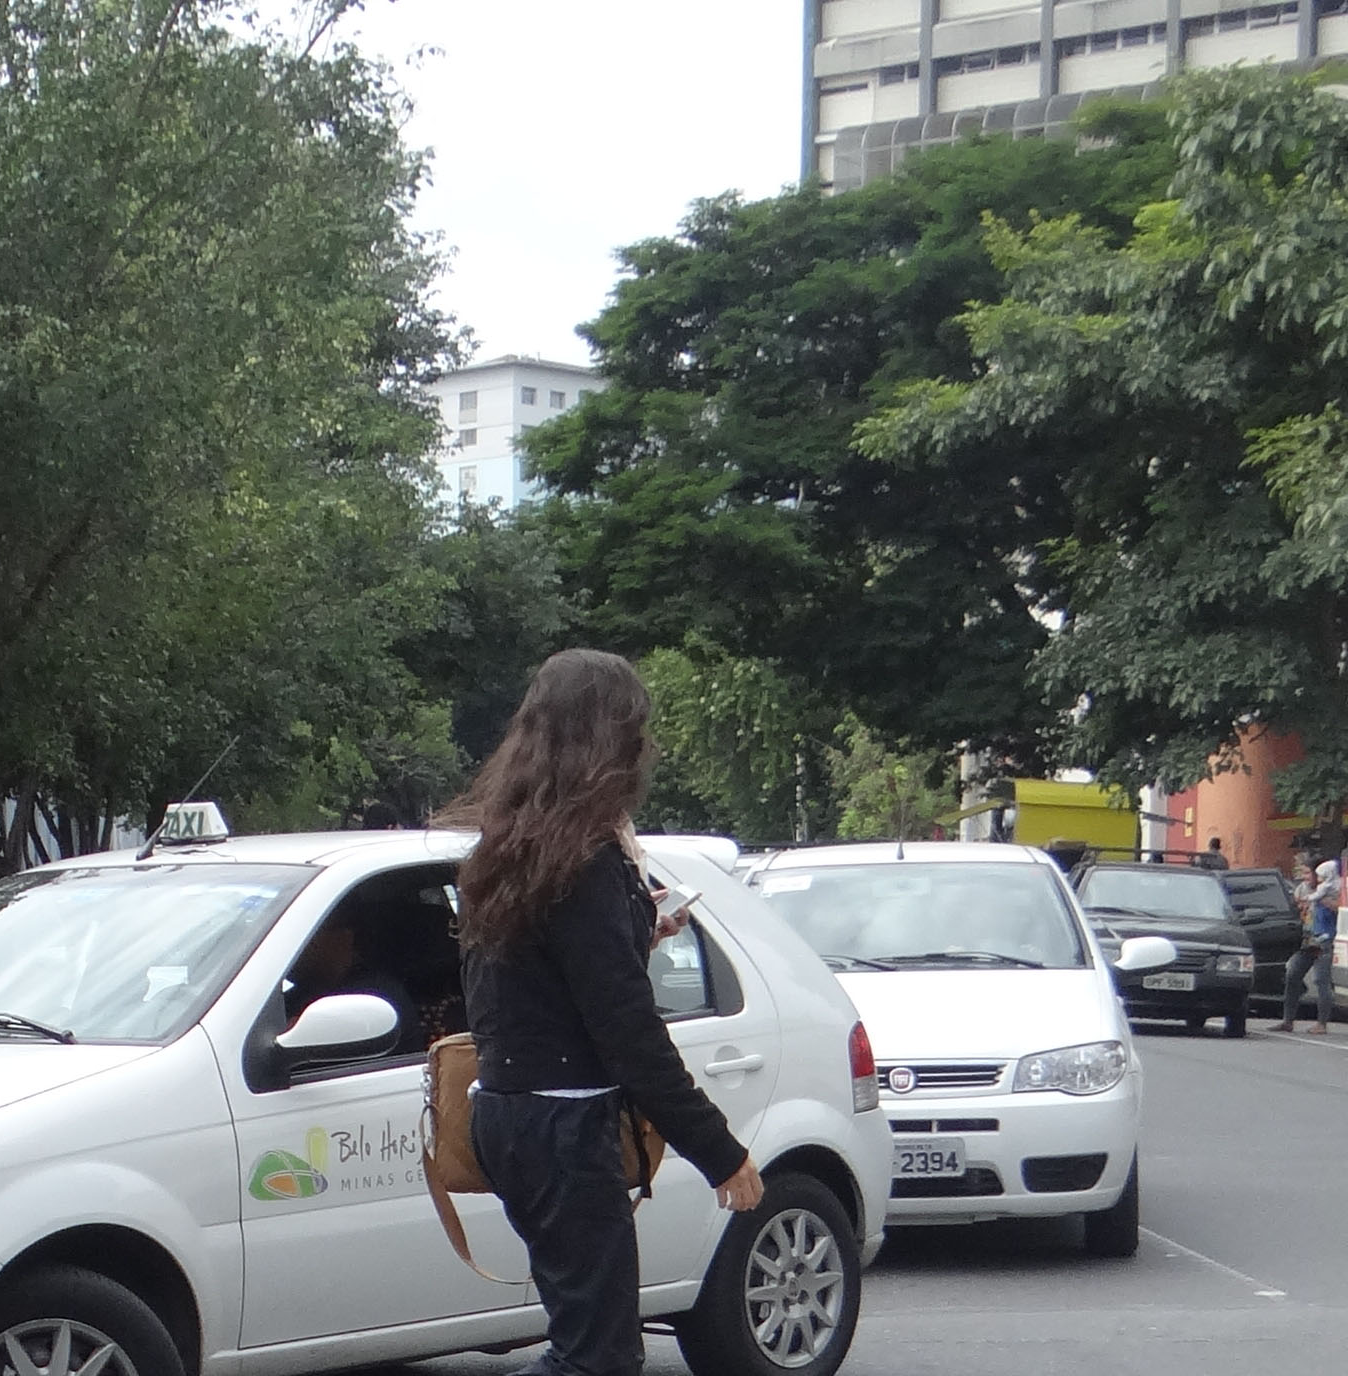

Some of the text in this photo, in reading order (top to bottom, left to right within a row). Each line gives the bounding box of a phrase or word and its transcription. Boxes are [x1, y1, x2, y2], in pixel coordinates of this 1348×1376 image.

[164, 811, 204, 837] TAXI
[331, 1124, 371, 1162] Belo
[900, 1151, 958, 1174] 2394
[341, 1170, 424, 1191] MINAS GE
